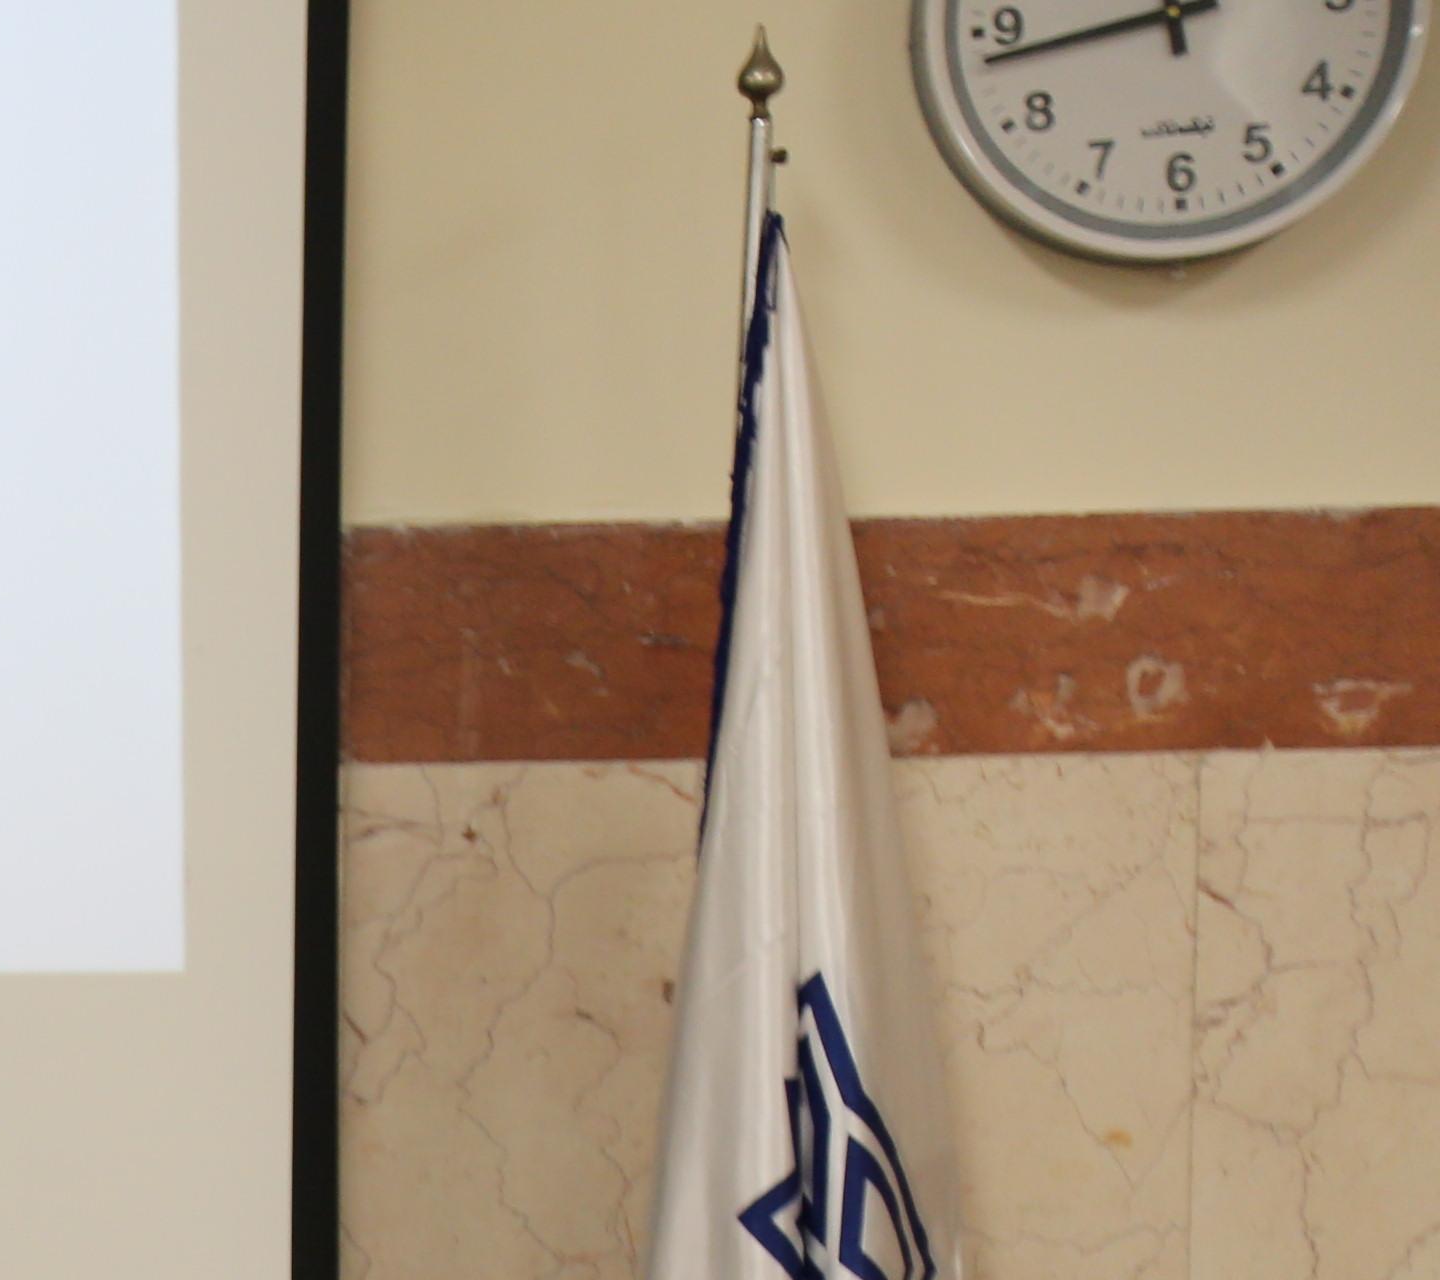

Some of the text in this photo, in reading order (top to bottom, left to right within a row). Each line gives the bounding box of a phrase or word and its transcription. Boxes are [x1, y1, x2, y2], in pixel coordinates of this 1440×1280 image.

[994, 6, 1023, 45] 9
[1301, 59, 1333, 101] 4
[1025, 91, 1055, 132] 8
[1088, 139, 1115, 179] 7
[1243, 122, 1272, 163] 5
[1165, 152, 1196, 193] 6
